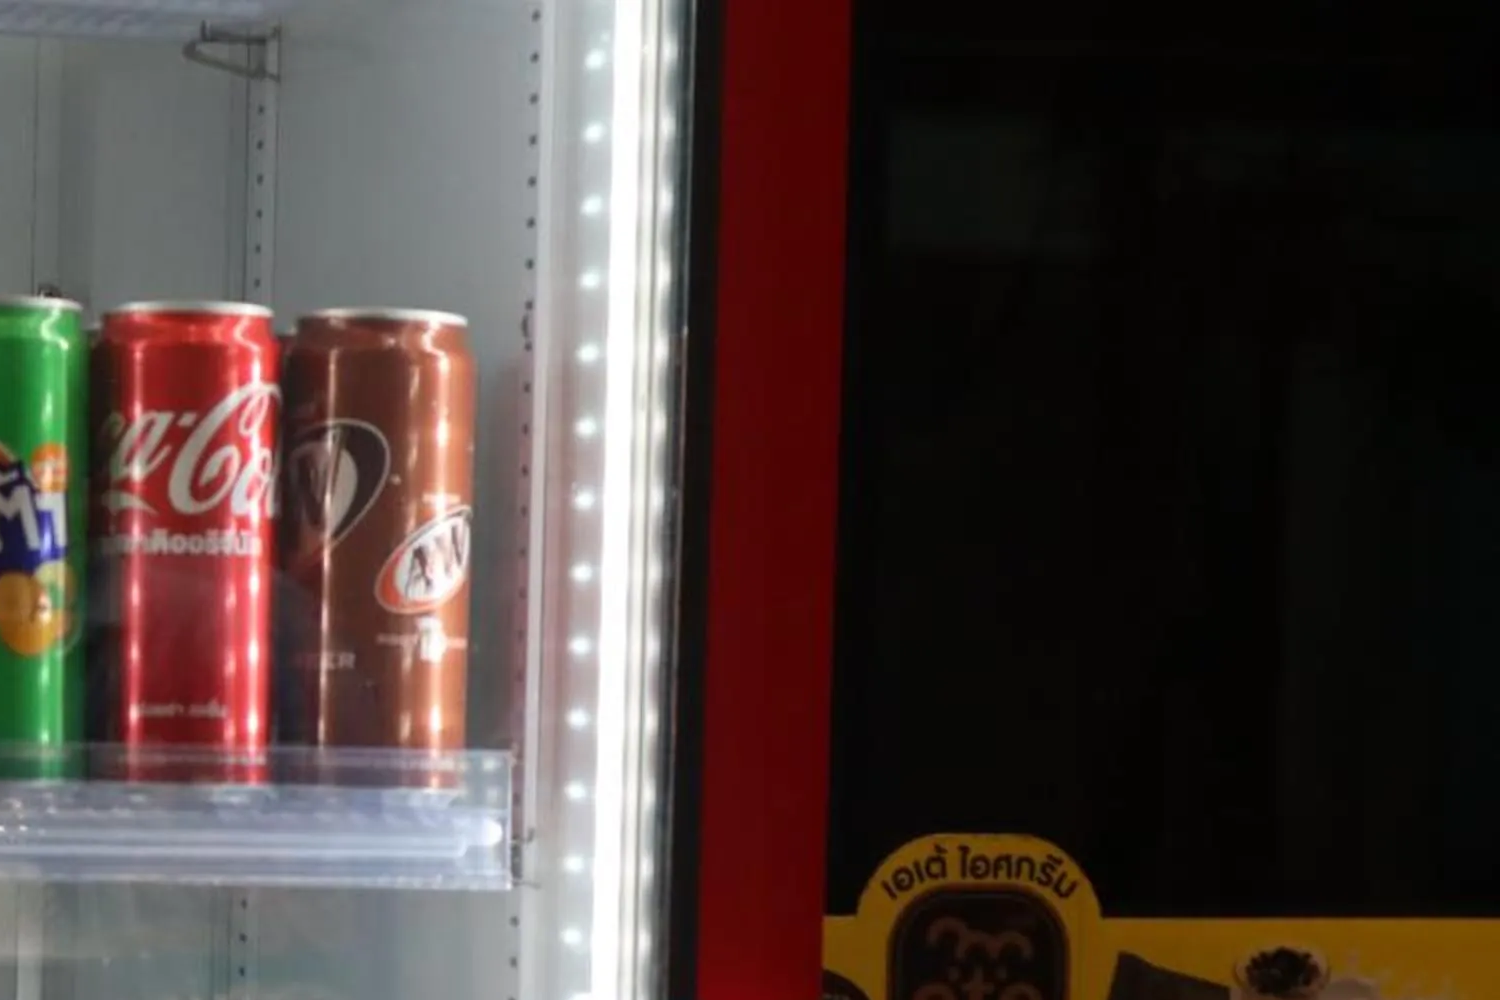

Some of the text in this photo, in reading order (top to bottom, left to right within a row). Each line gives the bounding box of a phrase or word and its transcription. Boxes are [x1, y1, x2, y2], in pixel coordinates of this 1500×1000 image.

[881, 844, 1079, 900] เอเต้ ไอศกรีม
